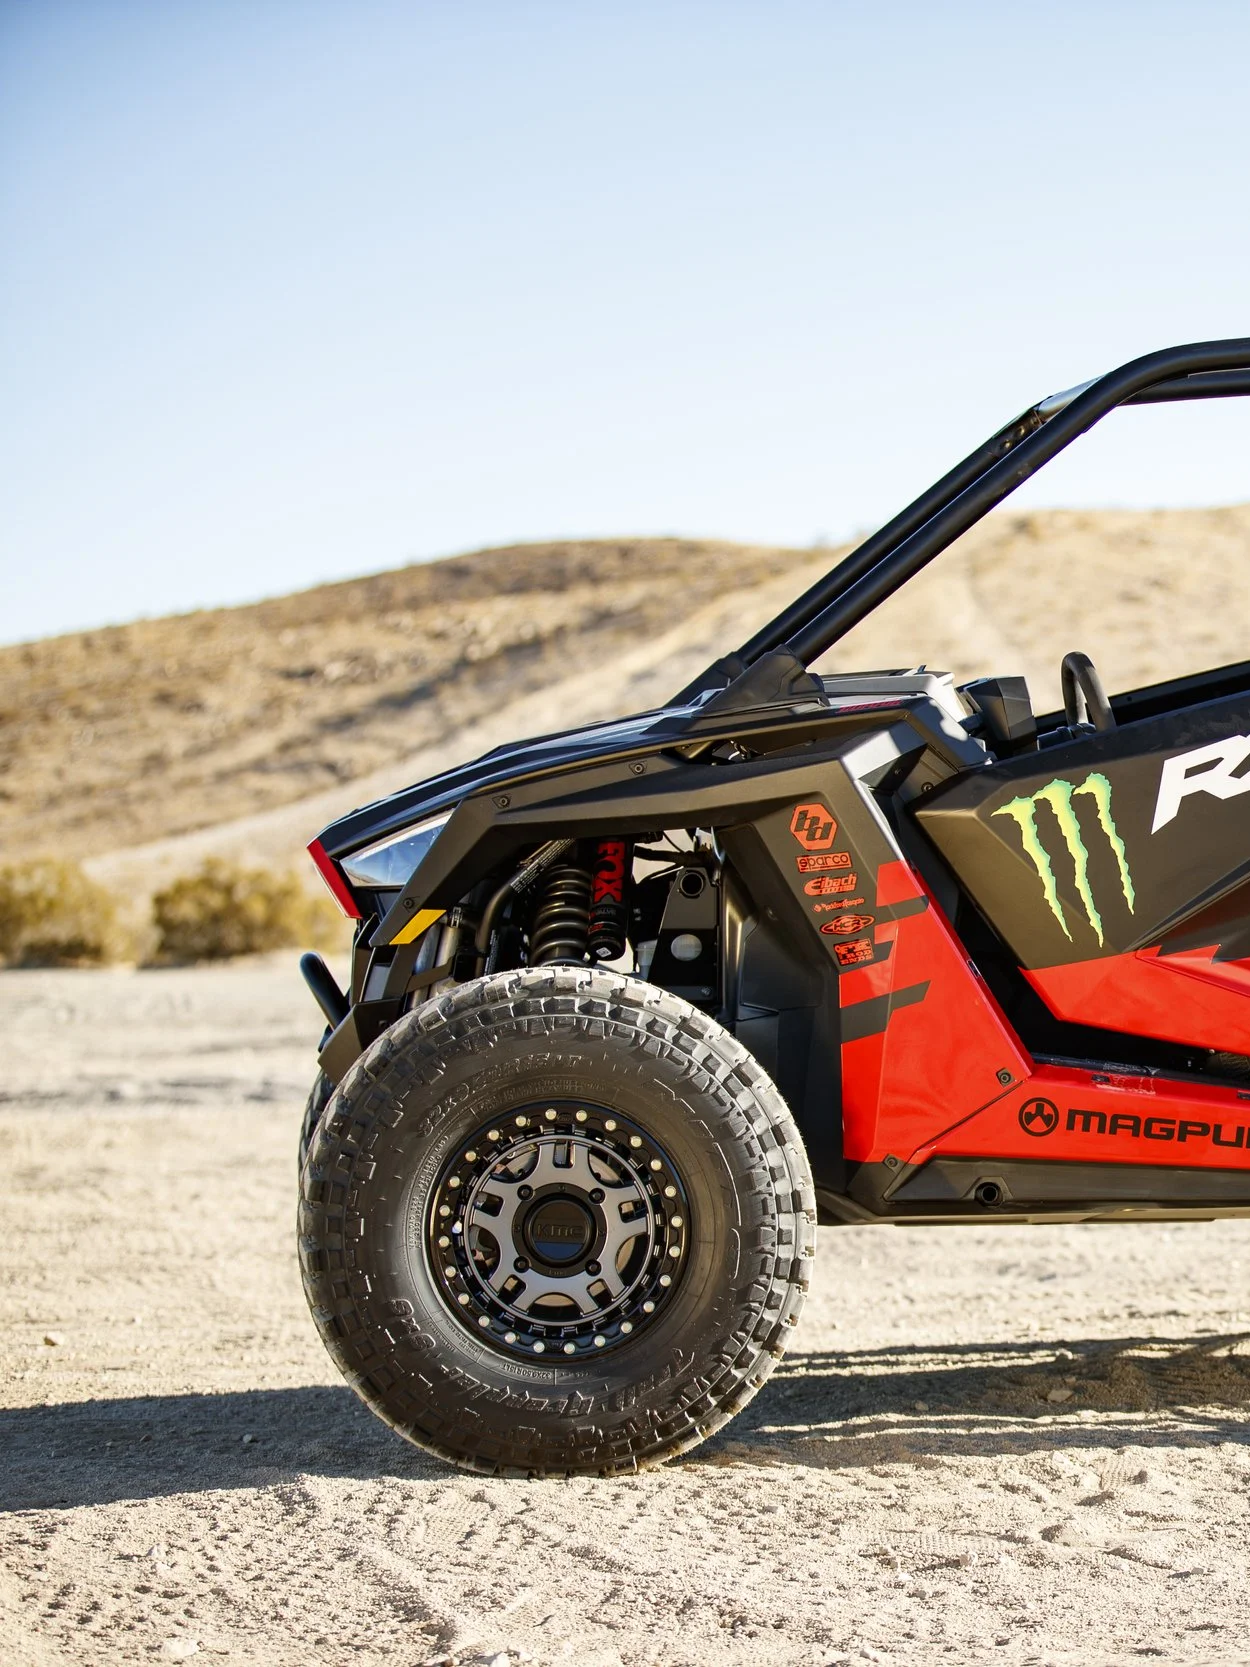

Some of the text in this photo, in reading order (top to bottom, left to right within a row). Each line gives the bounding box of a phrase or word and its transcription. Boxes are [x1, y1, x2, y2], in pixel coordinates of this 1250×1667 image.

[799, 854, 849, 870] sparco
[593, 841, 625, 903] FOX
[537, 1224, 583, 1238] KMC
